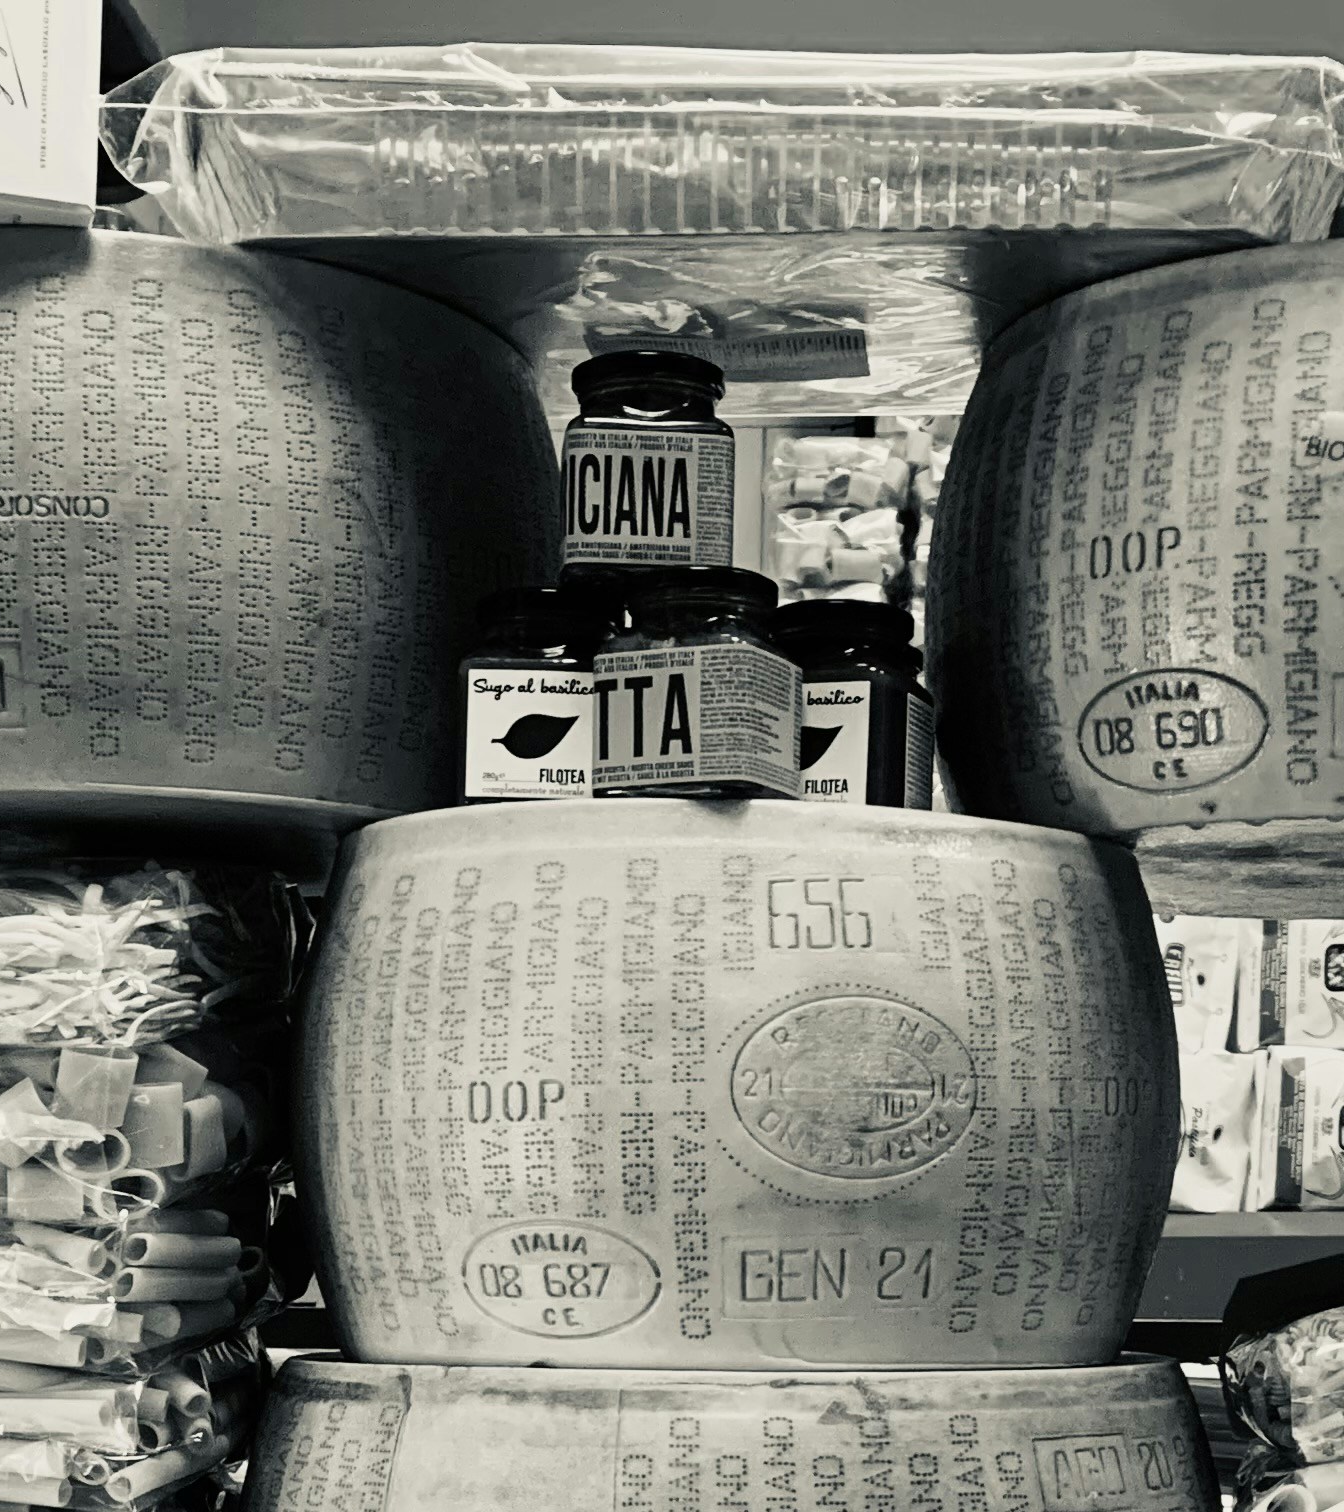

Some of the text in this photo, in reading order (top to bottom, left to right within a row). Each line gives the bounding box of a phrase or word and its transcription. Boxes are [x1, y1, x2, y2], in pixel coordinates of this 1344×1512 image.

[474, 678, 536, 700] Sugo al
[807, 690, 863, 706] basilico
[1124, 681, 1201, 710] ITALIA
[1094, 708, 1225, 756] 08 690
[539, 768, 585, 785] FILOTEA
[804, 778, 848, 795] FILOTEA
[767, 878, 872, 950] 656
[740, 1066, 773, 1098] 21
[510, 1232, 588, 1256] ITALIA
[479, 1262, 612, 1299] 08 687
[740, 1247, 934, 1303] GEN 21
